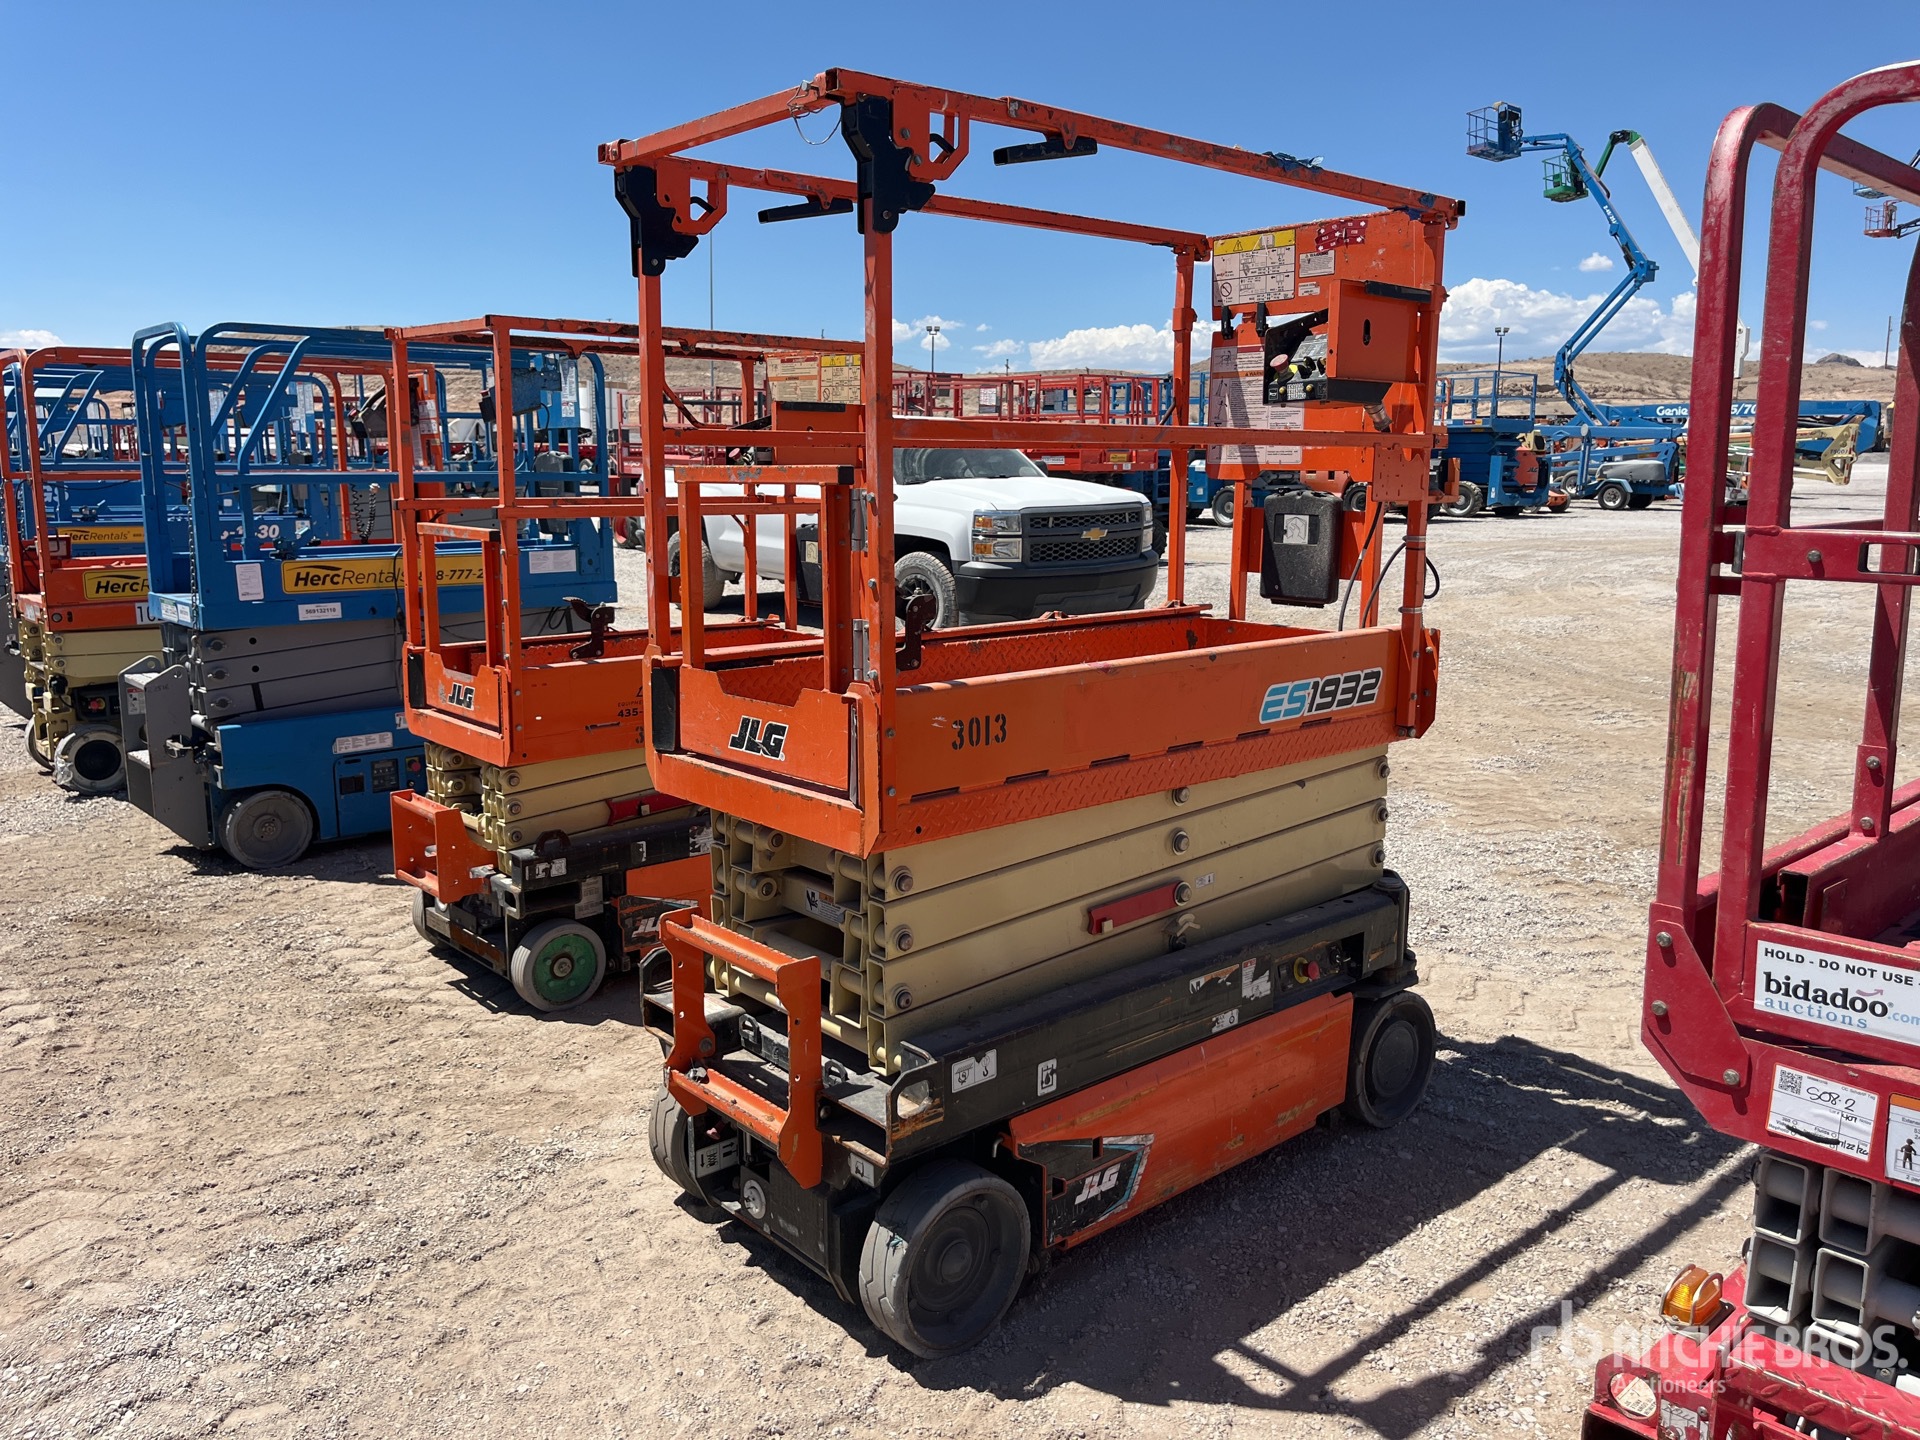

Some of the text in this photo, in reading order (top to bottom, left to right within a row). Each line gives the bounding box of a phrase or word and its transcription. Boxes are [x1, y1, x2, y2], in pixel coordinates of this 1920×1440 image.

[1656, 405, 1689, 416] Genie
[294, 569, 405, 588] HercRentals
[448, 682, 475, 710] JLG
[1259, 667, 1383, 724] ES1932
[728, 715, 789, 760] JLG
[952, 713, 1007, 750] 3013
[1764, 947, 1805, 964] HOLD
[1818, 958, 1840, 971] DO
[1845, 963, 1877, 979] NOT
[1882, 971, 1914, 986] USE
[1764, 997, 1868, 1029] auctions
[1074, 1162, 1121, 1206] JLG
